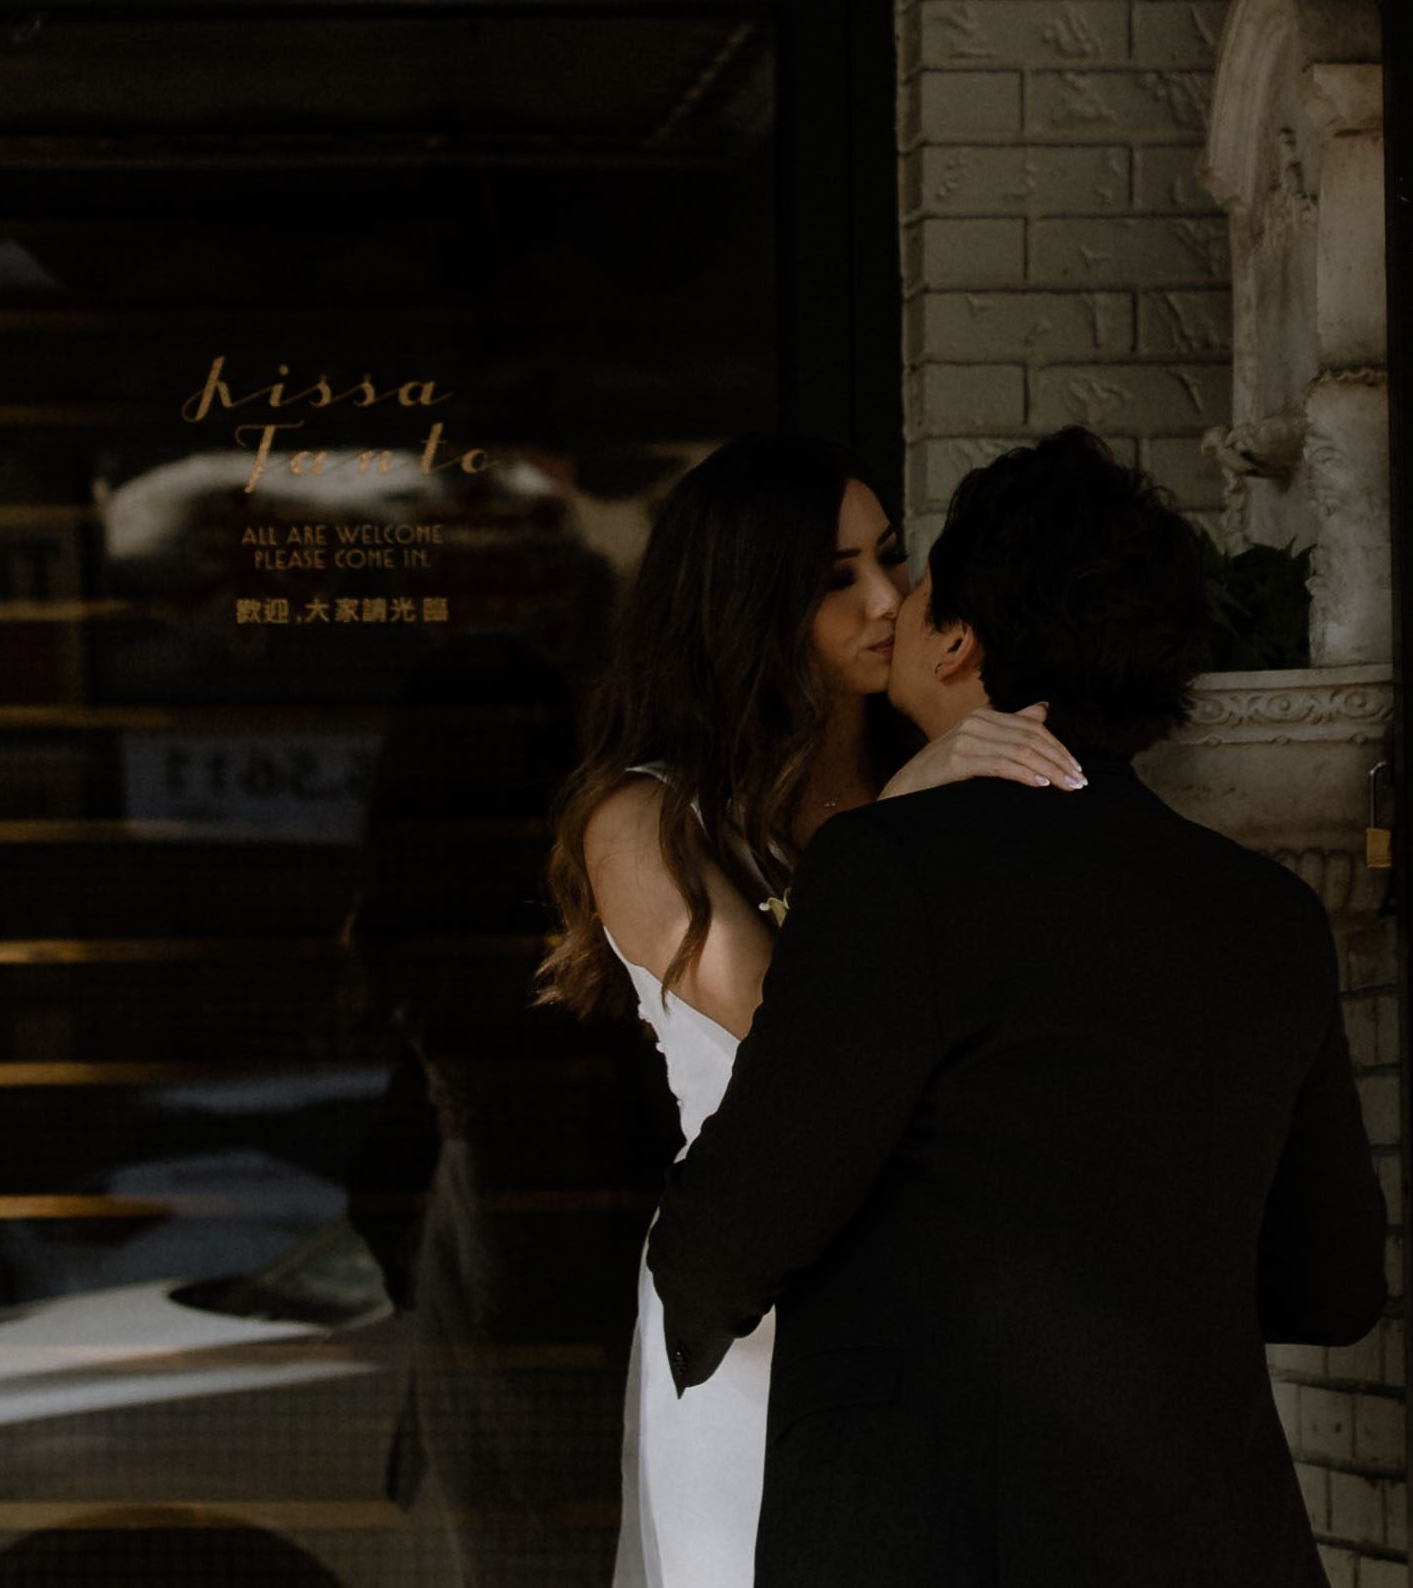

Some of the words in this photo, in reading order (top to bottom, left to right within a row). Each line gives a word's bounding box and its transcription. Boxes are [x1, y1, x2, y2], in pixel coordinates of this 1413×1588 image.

[235, 420, 497, 494] Tanto
[240, 525, 278, 547] ALL
[286, 524, 328, 546] ARE
[336, 522, 445, 546] WELCOME
[254, 550, 326, 571] PLEASE
[334, 549, 396, 570] COME
